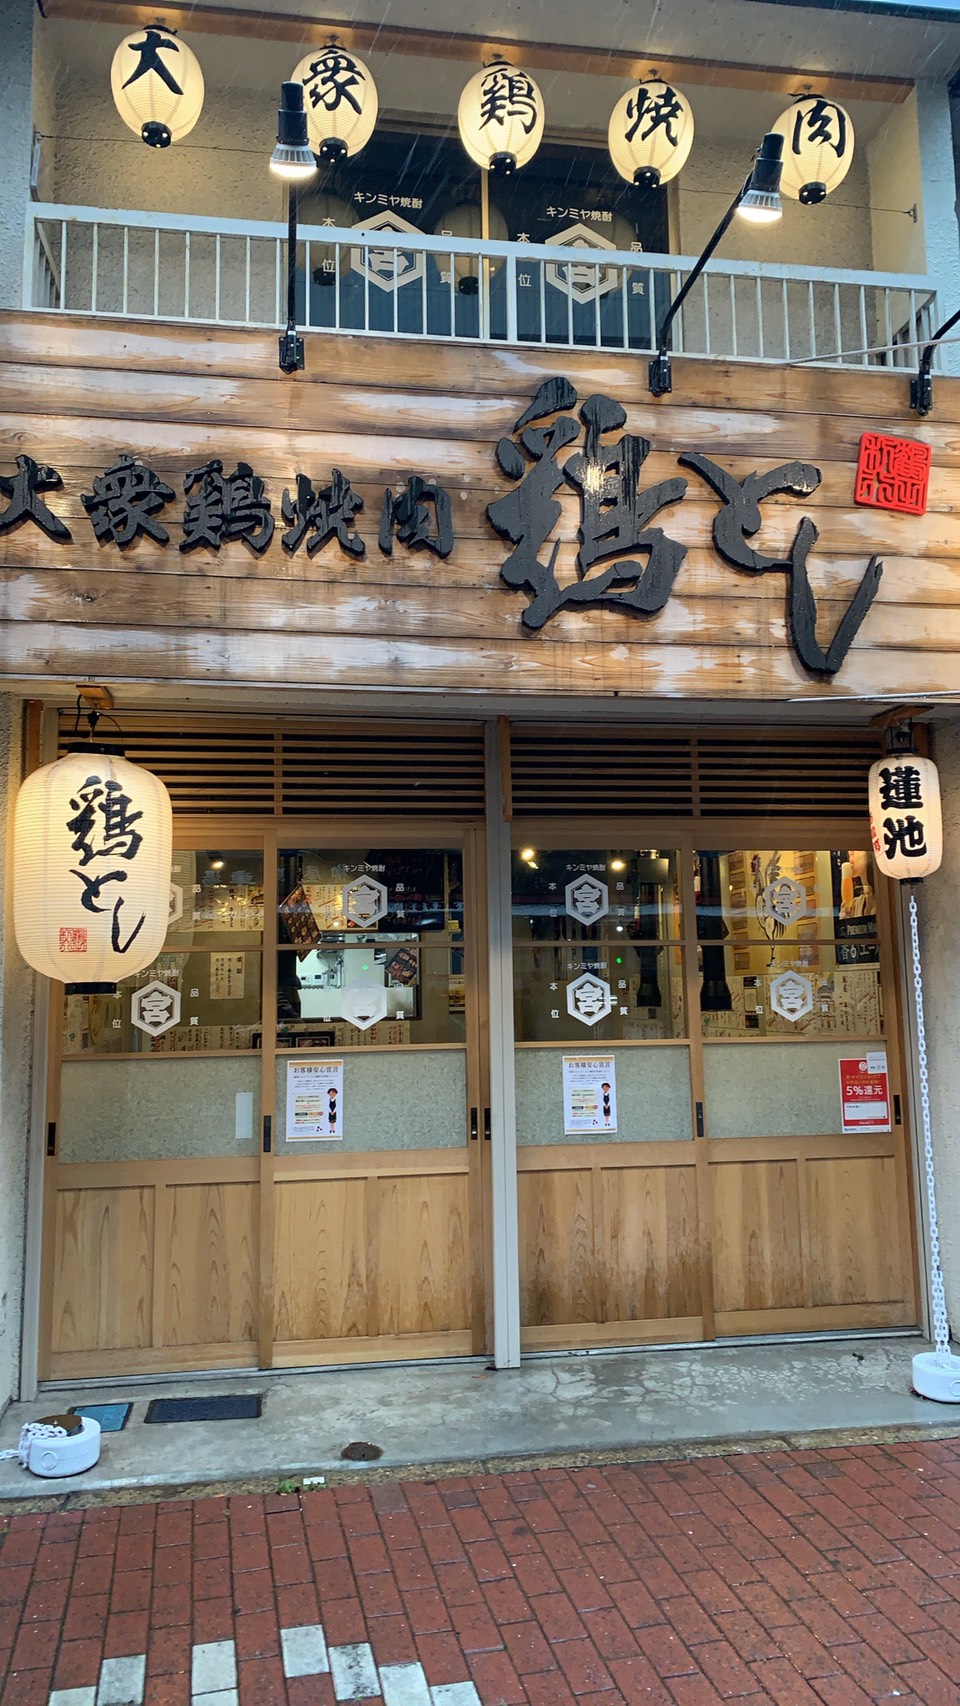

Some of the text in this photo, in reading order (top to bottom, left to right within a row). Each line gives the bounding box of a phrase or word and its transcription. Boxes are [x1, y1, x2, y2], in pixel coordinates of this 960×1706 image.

[122, 30, 184, 95] 大
[302, 49, 366, 115] 衆
[479, 66, 536, 135] 鶏
[624, 87, 684, 147] 焼
[791, 99, 846, 158] 肉
[353, 191, 424, 210] キンミヤ焼酎
[546, 206, 613, 223] キンミヤ焼酎
[0, 454, 454, 560] 大衆鶏焼肉
[878, 765, 928, 860] 蓮池
[565, 863, 606, 872] キンミヤ焼酎
[846, 1085, 884, 1096] 5%還元
